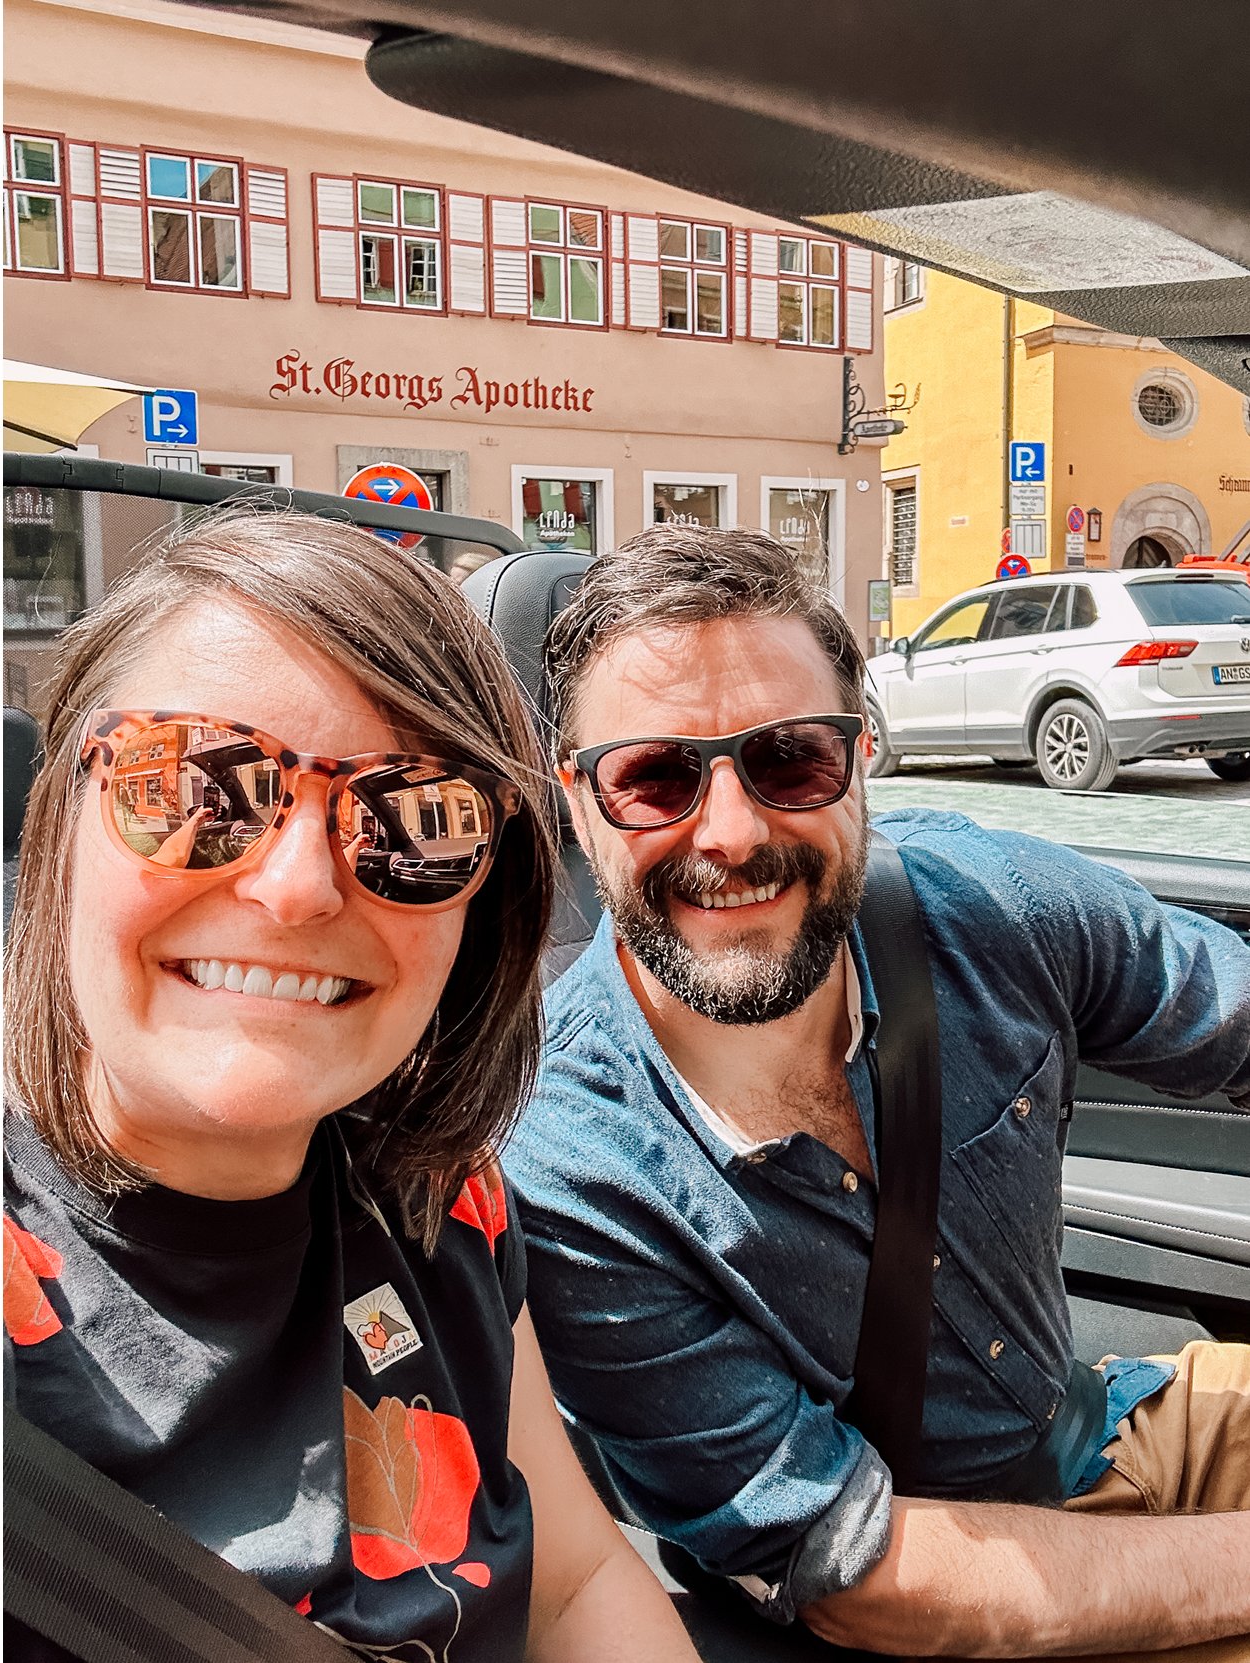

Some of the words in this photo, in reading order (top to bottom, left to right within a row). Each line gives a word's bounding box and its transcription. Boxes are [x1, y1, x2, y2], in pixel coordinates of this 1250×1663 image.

[450, 366, 596, 414] Apotheke
[152, 395, 181, 436] P
[1015, 446, 1036, 478] P
[1220, 667, 1234, 680] AN
[395, 1338, 418, 1359] PEOPLE
